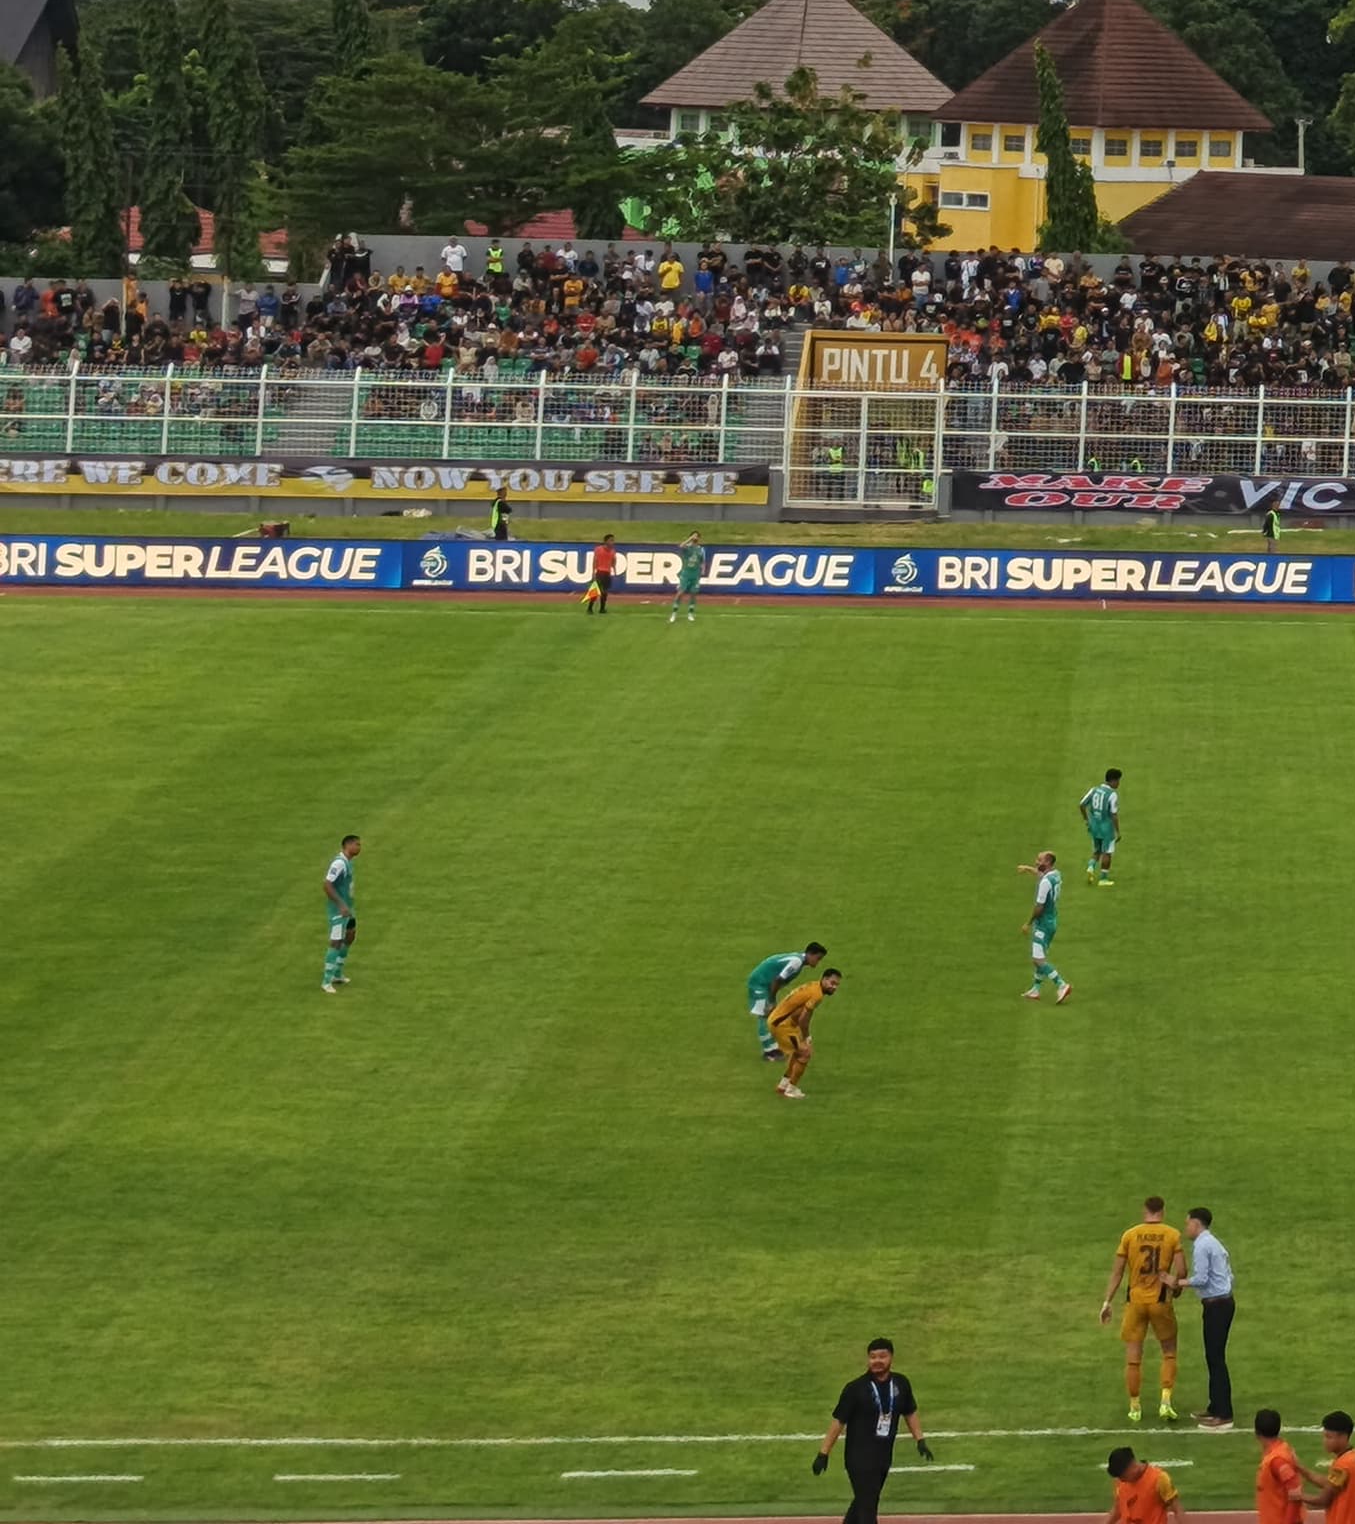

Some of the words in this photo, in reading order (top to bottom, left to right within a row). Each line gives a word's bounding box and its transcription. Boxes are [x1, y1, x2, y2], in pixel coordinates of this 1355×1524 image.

[822, 348, 910, 384] PINTU
[919, 349, 939, 385] 4
[77, 461, 147, 486] WE
[154, 461, 285, 488] COME
[371, 465, 476, 491] NOW
[478, 467, 576, 493] YOU
[584, 469, 666, 494] SEE
[676, 470, 740, 496] ME
[979, 473, 1214, 493] MAKE
[1004, 490, 1186, 510] OUR
[468, 549, 531, 583] BRI
[937, 556, 998, 590] BRI
[1139, 1244, 1161, 1275] 31
